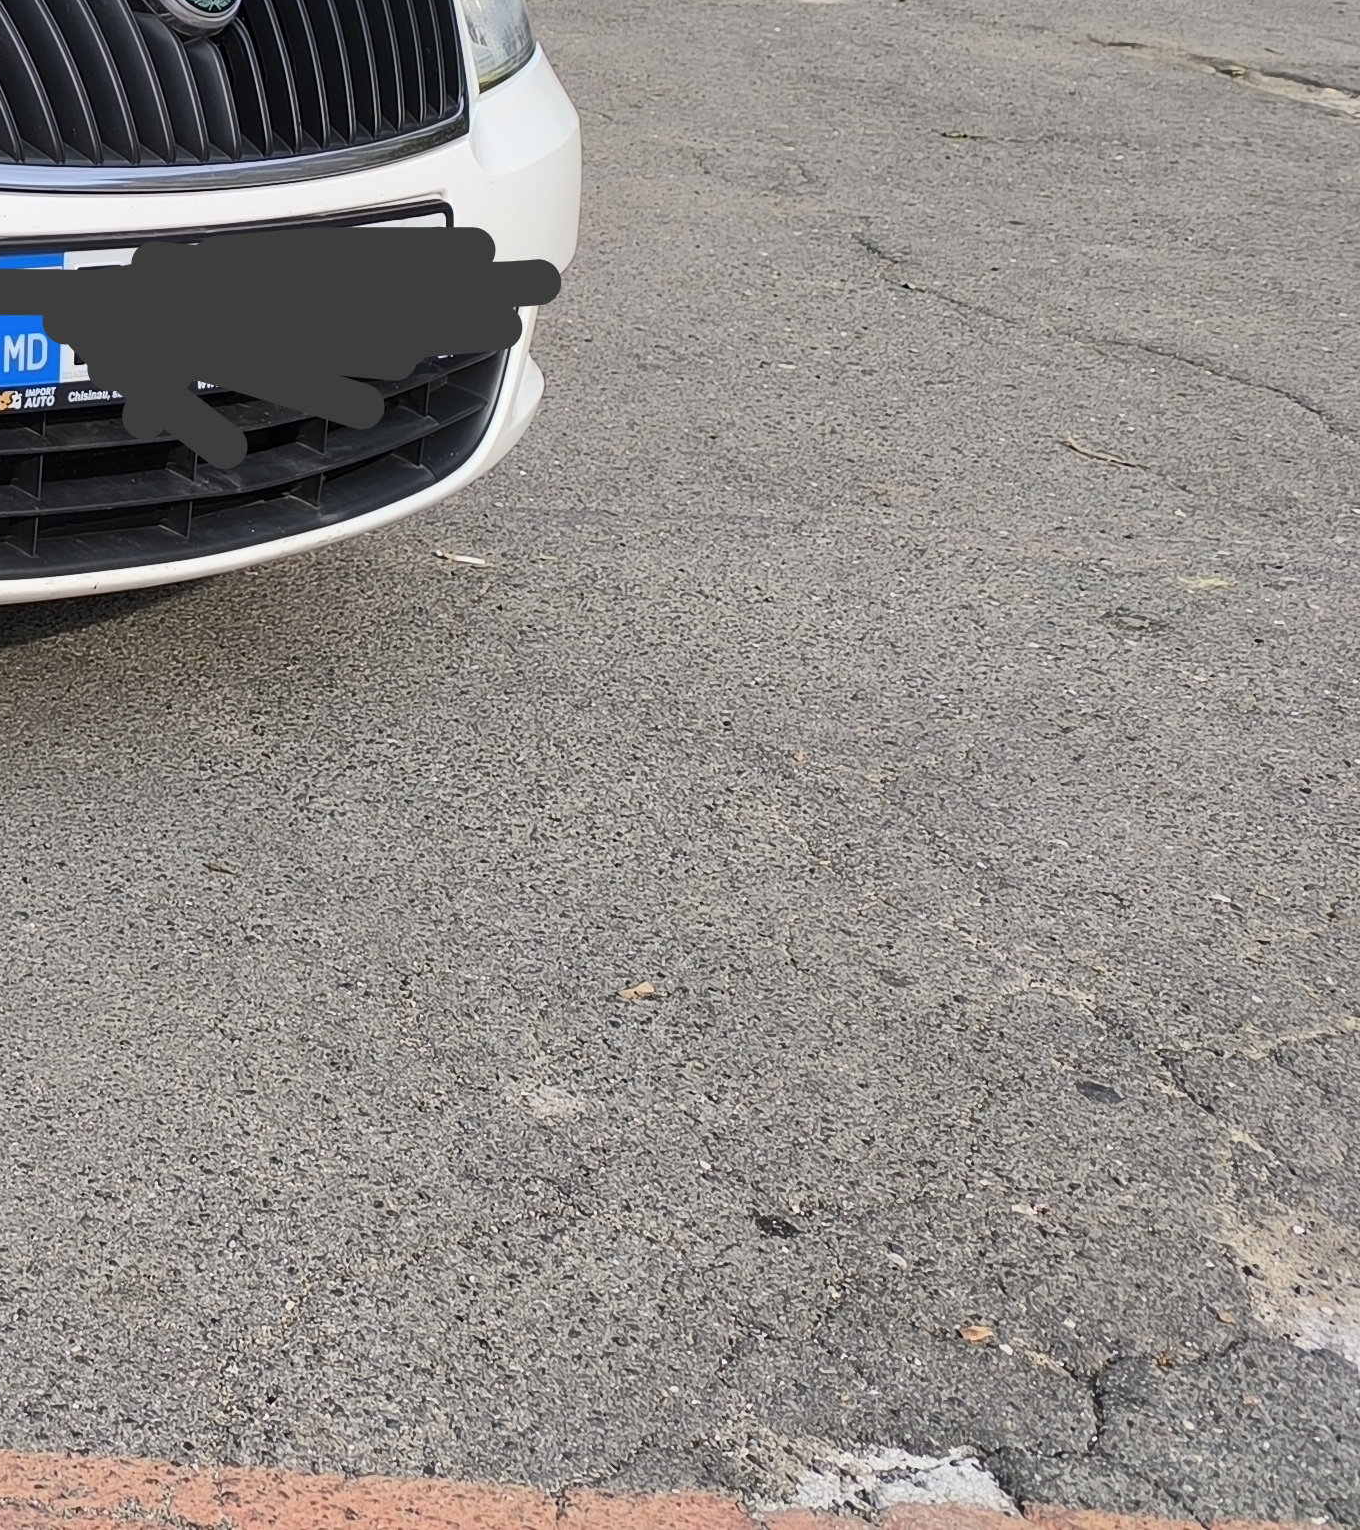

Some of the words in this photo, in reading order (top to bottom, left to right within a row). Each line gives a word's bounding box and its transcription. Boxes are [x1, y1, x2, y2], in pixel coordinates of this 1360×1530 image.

[3, 332, 48, 373] MD
[25, 387, 56, 397] IMPORT
[24, 395, 55, 408] AUTO
